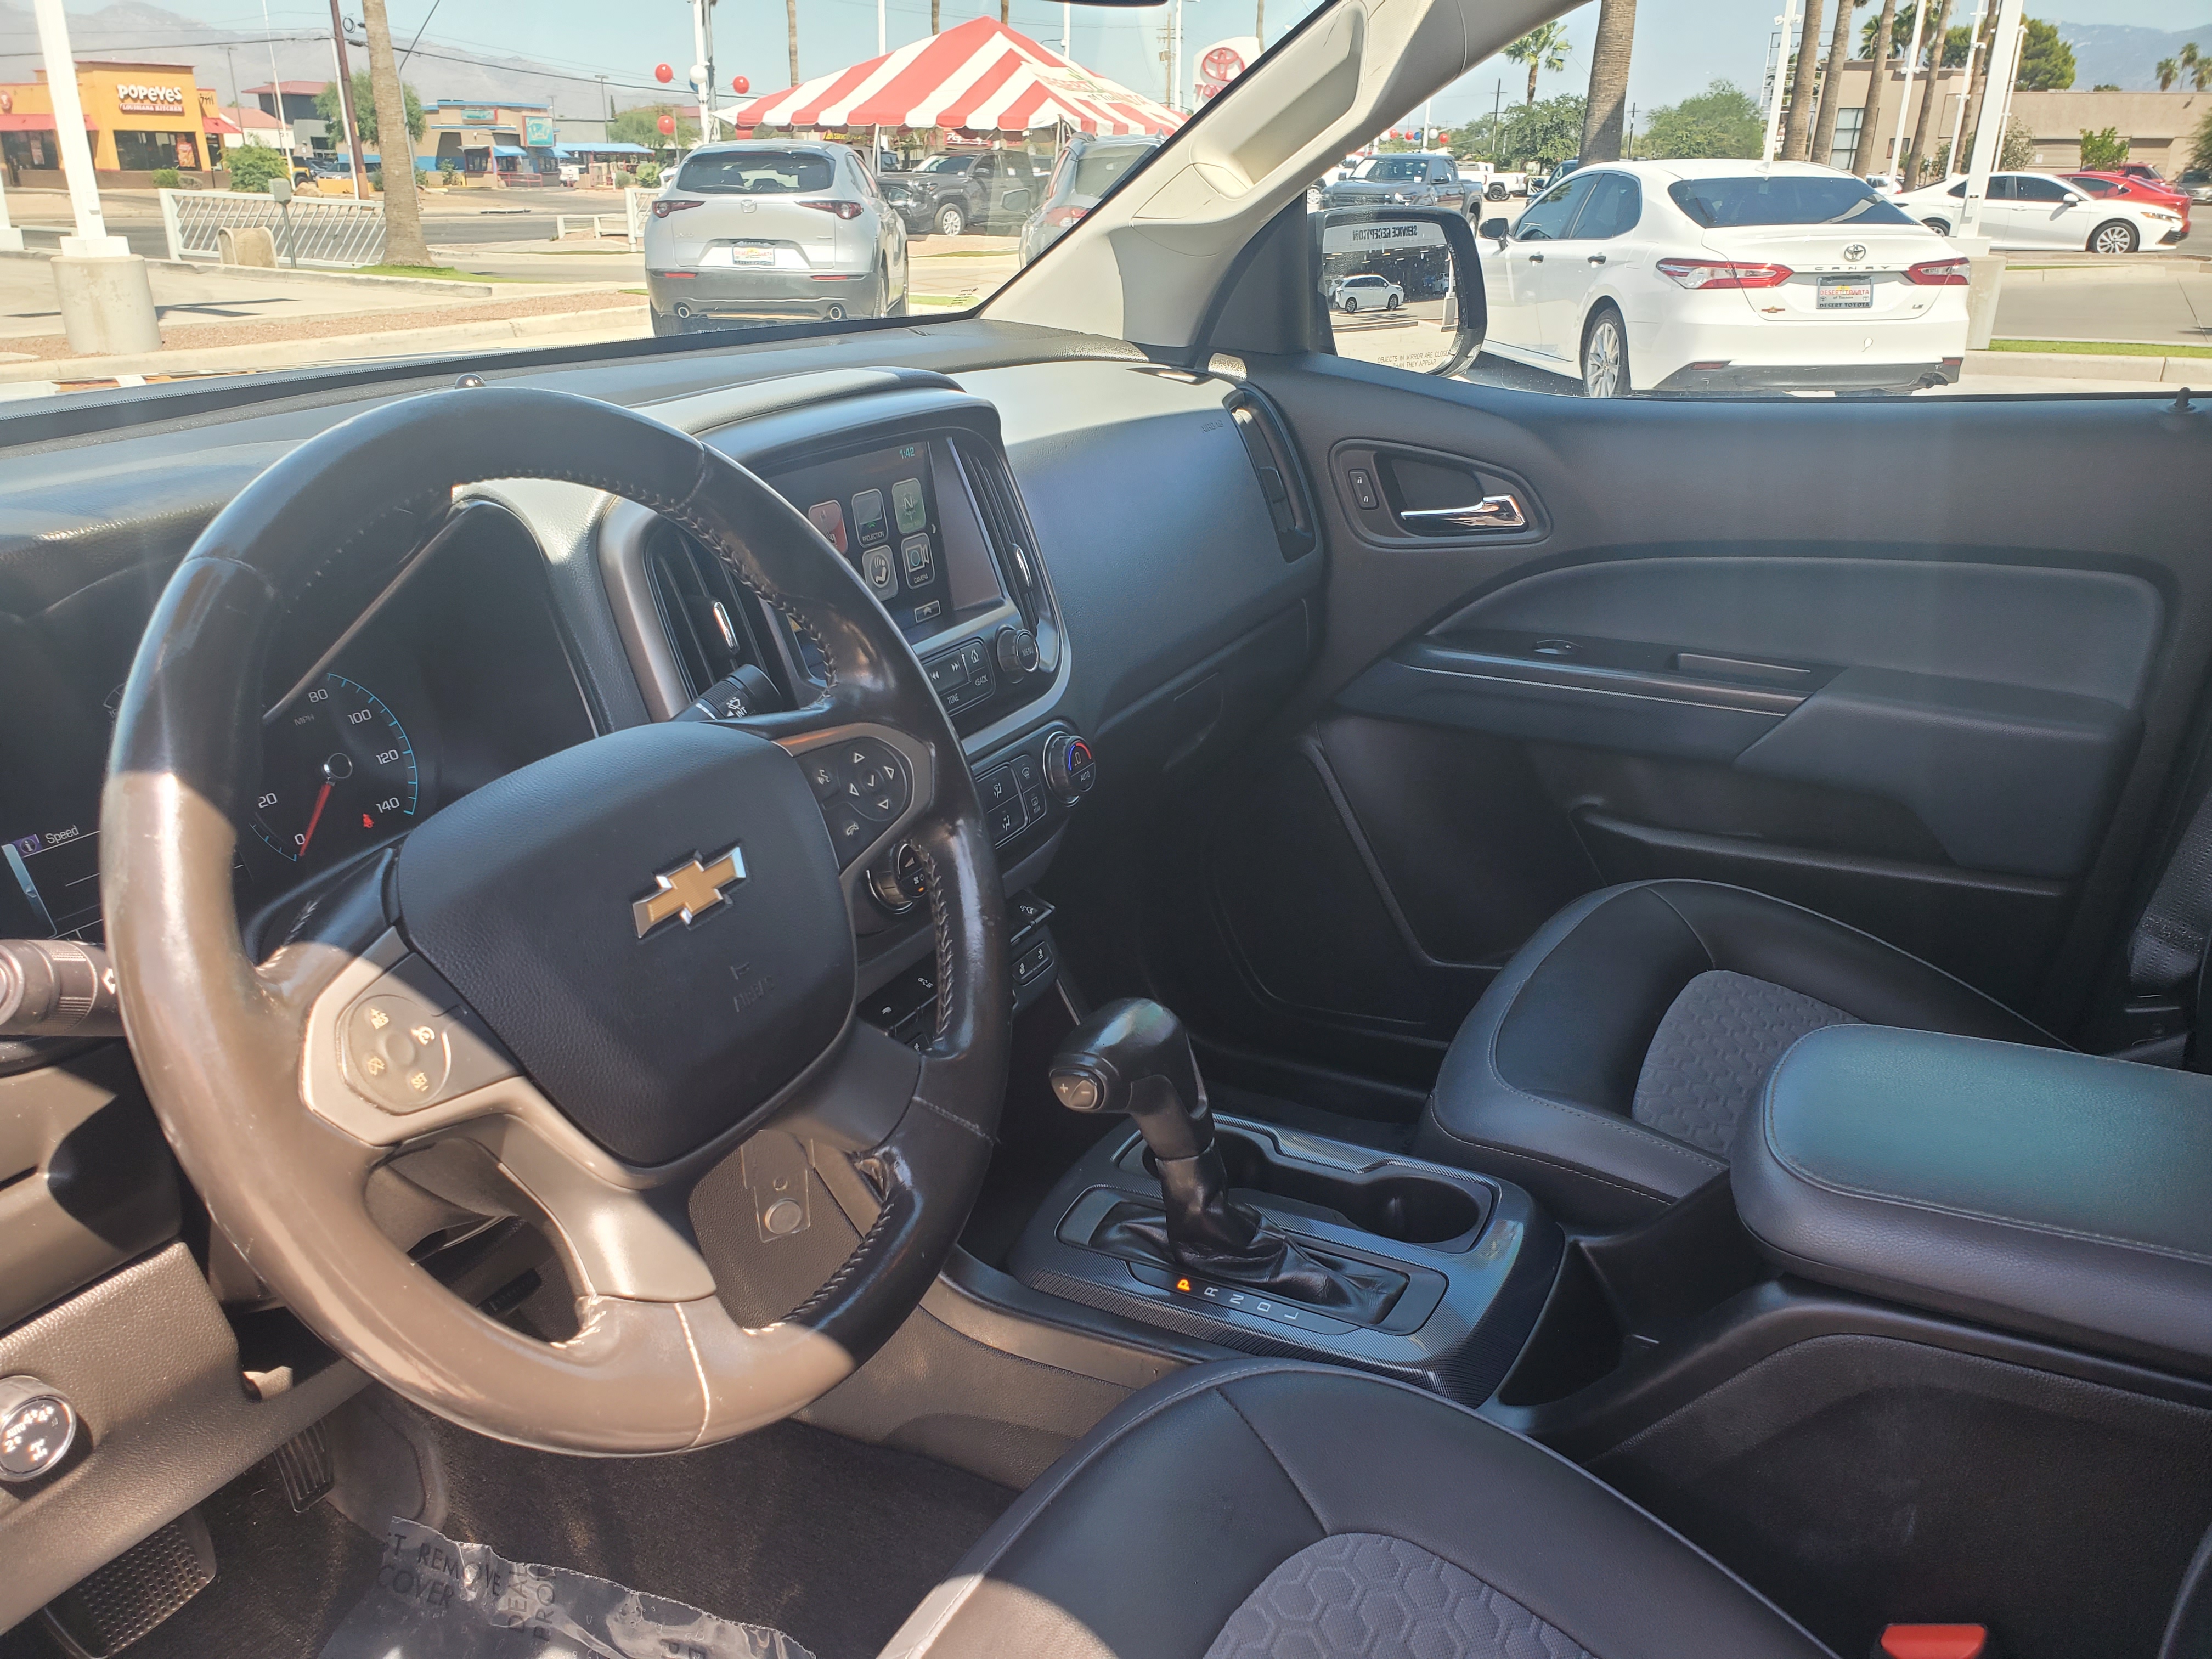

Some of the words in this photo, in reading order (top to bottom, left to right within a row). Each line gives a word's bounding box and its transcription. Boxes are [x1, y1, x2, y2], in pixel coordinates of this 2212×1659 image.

[899, 447, 915, 459] 1:42
[862, 531, 885, 543] PROJECTION
[913, 573, 929, 584] CAMERA
[1022, 647, 1034, 657] MENU
[977, 674, 988, 686] BACK
[308, 689, 329, 703] 80
[947, 693, 960, 706] TONE
[347, 709, 373, 725] 100
[735, 707, 747, 718] INT
[294, 714, 315, 726] MPH
[376, 749, 399, 765] 120
[1080, 770, 1090, 782] AUTO
[258, 793, 278, 809] 20
[376, 797, 400, 814] 140
[45, 825, 80, 844] Speed
[294, 833, 306, 845] 0
[1177, 1279, 1190, 1291] P
[1204, 1286, 1218, 1297] R
[1229, 1294, 1245, 1305] N
[1257, 1301, 1271, 1312] D
[1284, 1312, 1299, 1321] L
[6, 1422, 27, 1439] AUTO
[378, 1565, 454, 1609] COVER
